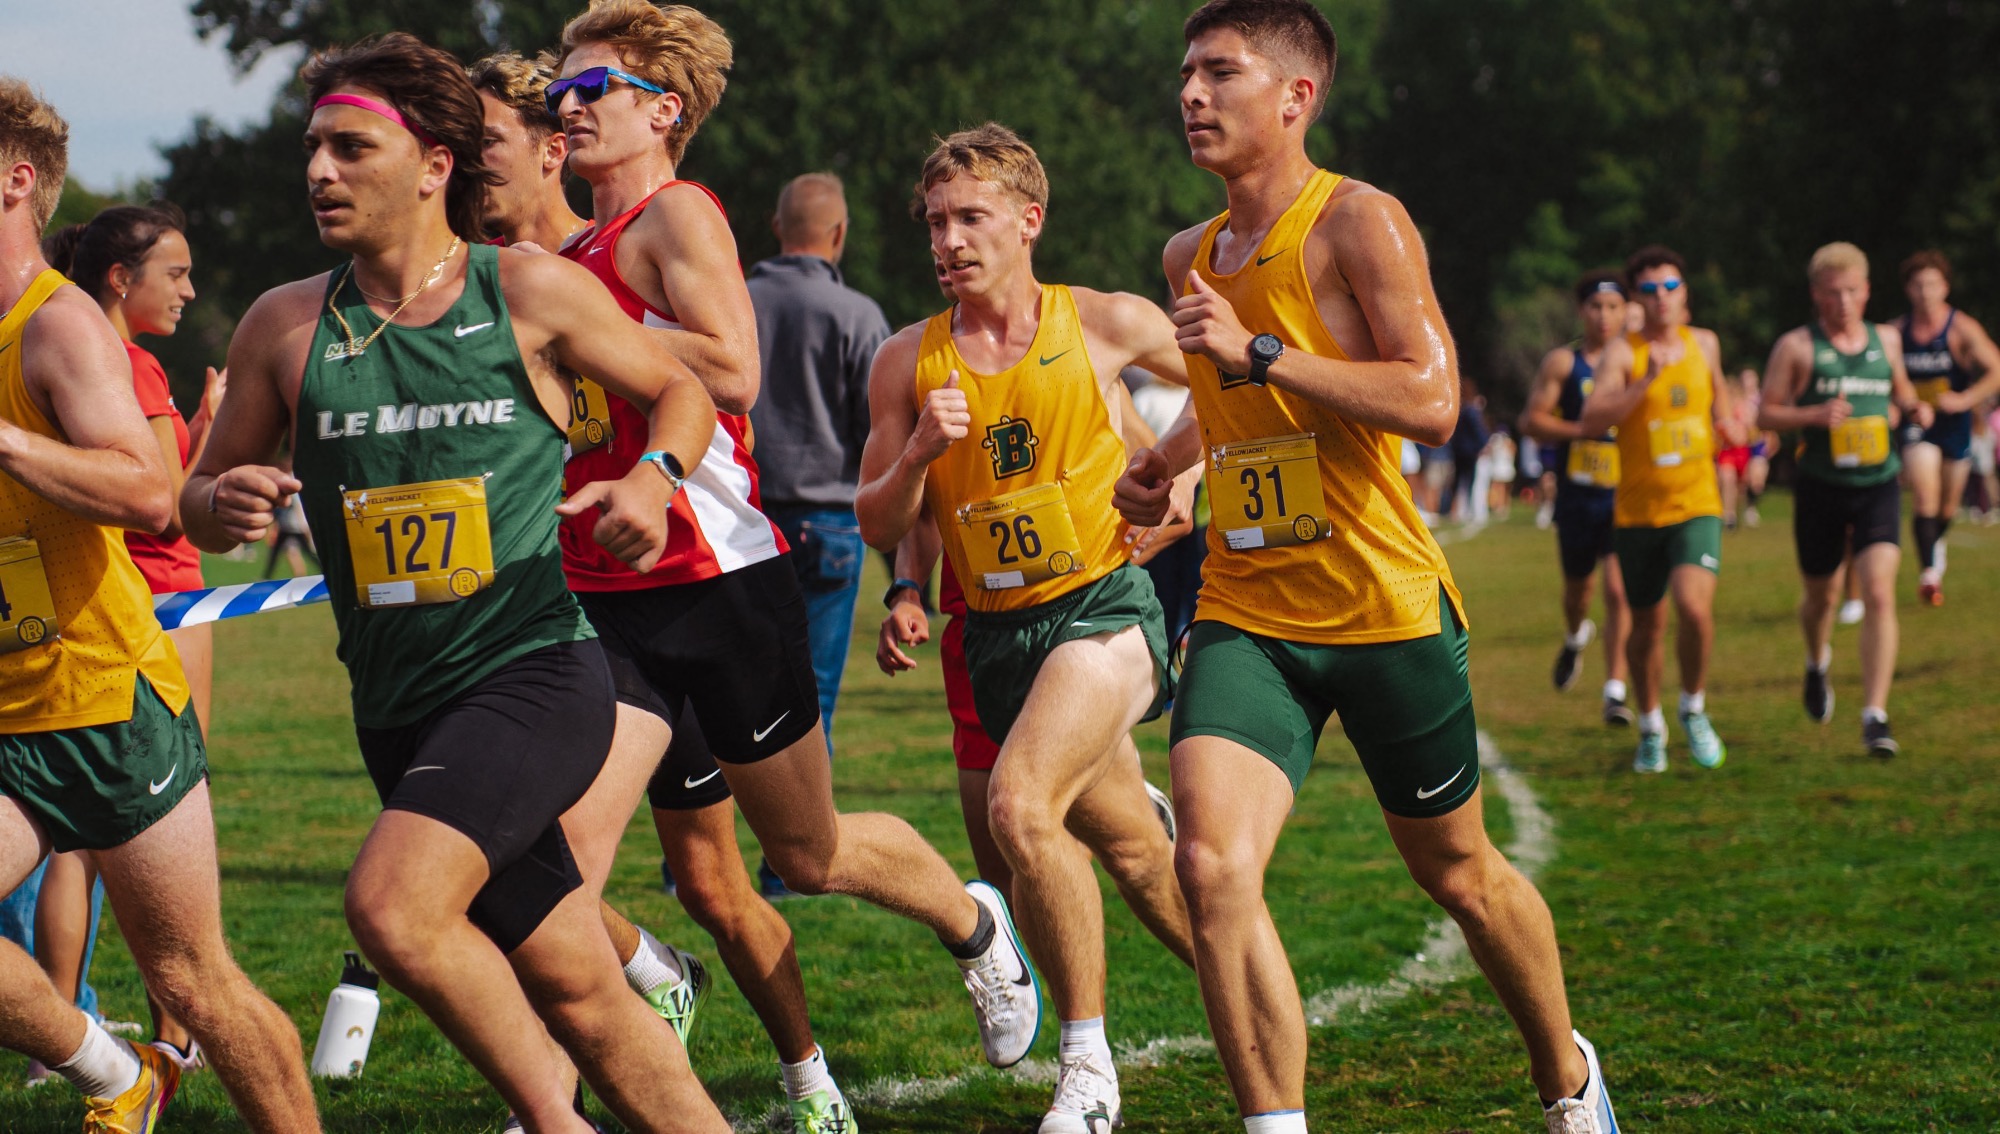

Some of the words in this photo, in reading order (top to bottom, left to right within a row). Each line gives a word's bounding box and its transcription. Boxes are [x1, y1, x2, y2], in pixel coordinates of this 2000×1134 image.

[317, 411, 369, 440] LE
[376, 398, 515, 434] MOYNE
[568, 373, 588, 428] 6
[986, 417, 1036, 481] B
[1240, 464, 1287, 521] 31
[374, 511, 456, 576] 127
[989, 514, 1043, 566] 26
[23, 620, 42, 641] R
